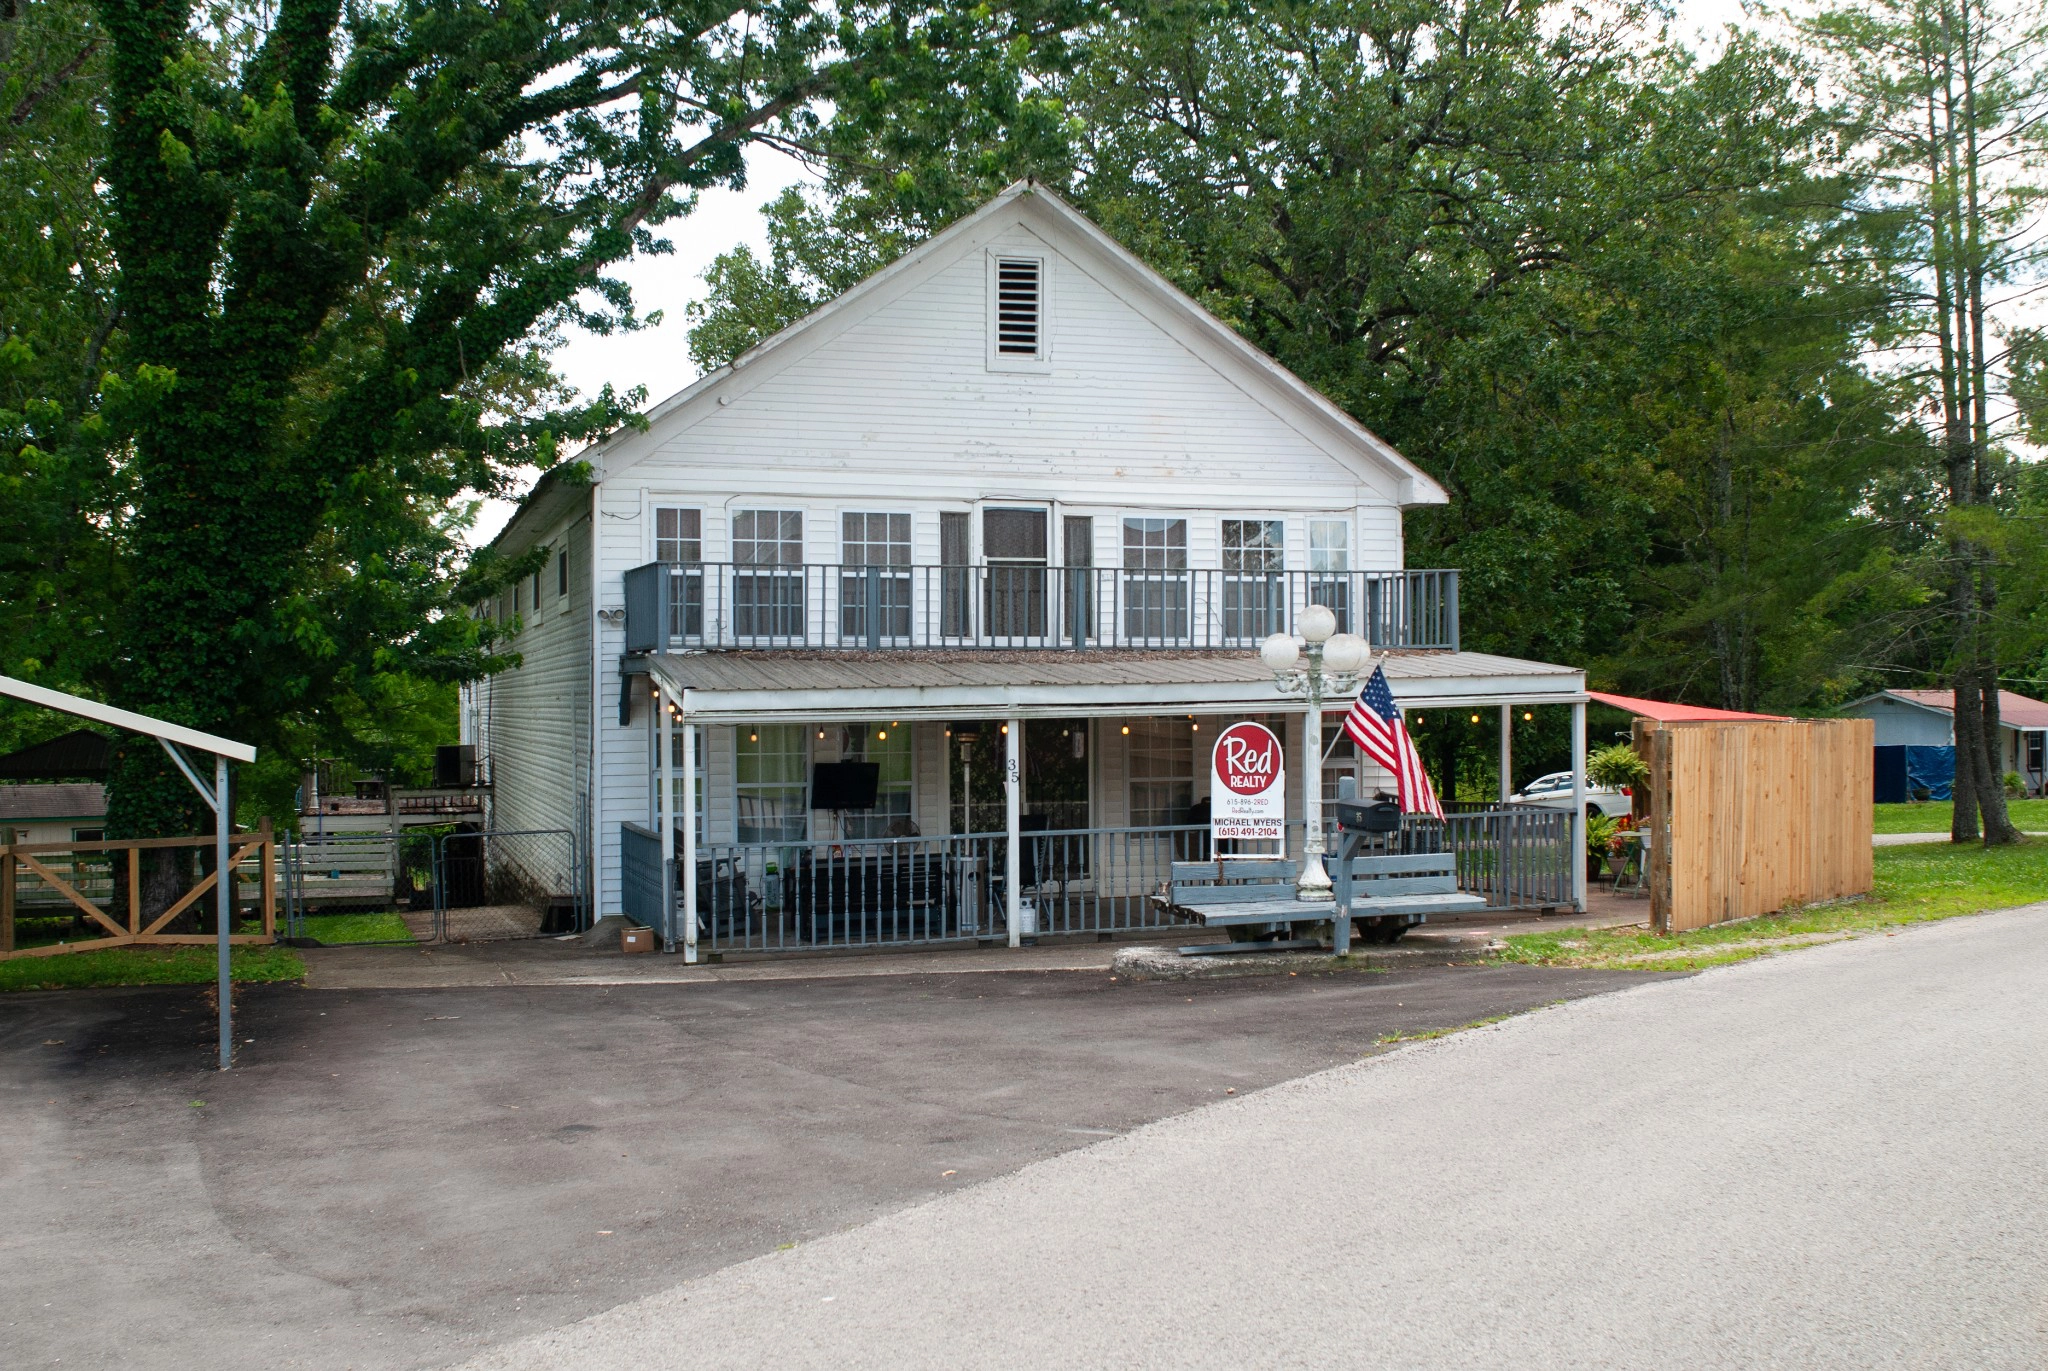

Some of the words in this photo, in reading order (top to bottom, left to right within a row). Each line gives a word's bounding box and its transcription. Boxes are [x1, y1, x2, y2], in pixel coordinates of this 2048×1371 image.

[1223, 736, 1272, 774] Red
[1230, 775, 1267, 788] REALTY
[1226, 798, 1269, 806] 615-896-2RED
[1214, 818, 1251, 826] MICHAEL
[1253, 818, 1282, 826] MYERS
[1218, 827, 1239, 836] (615)
[1240, 827, 1278, 836] 491-2104
